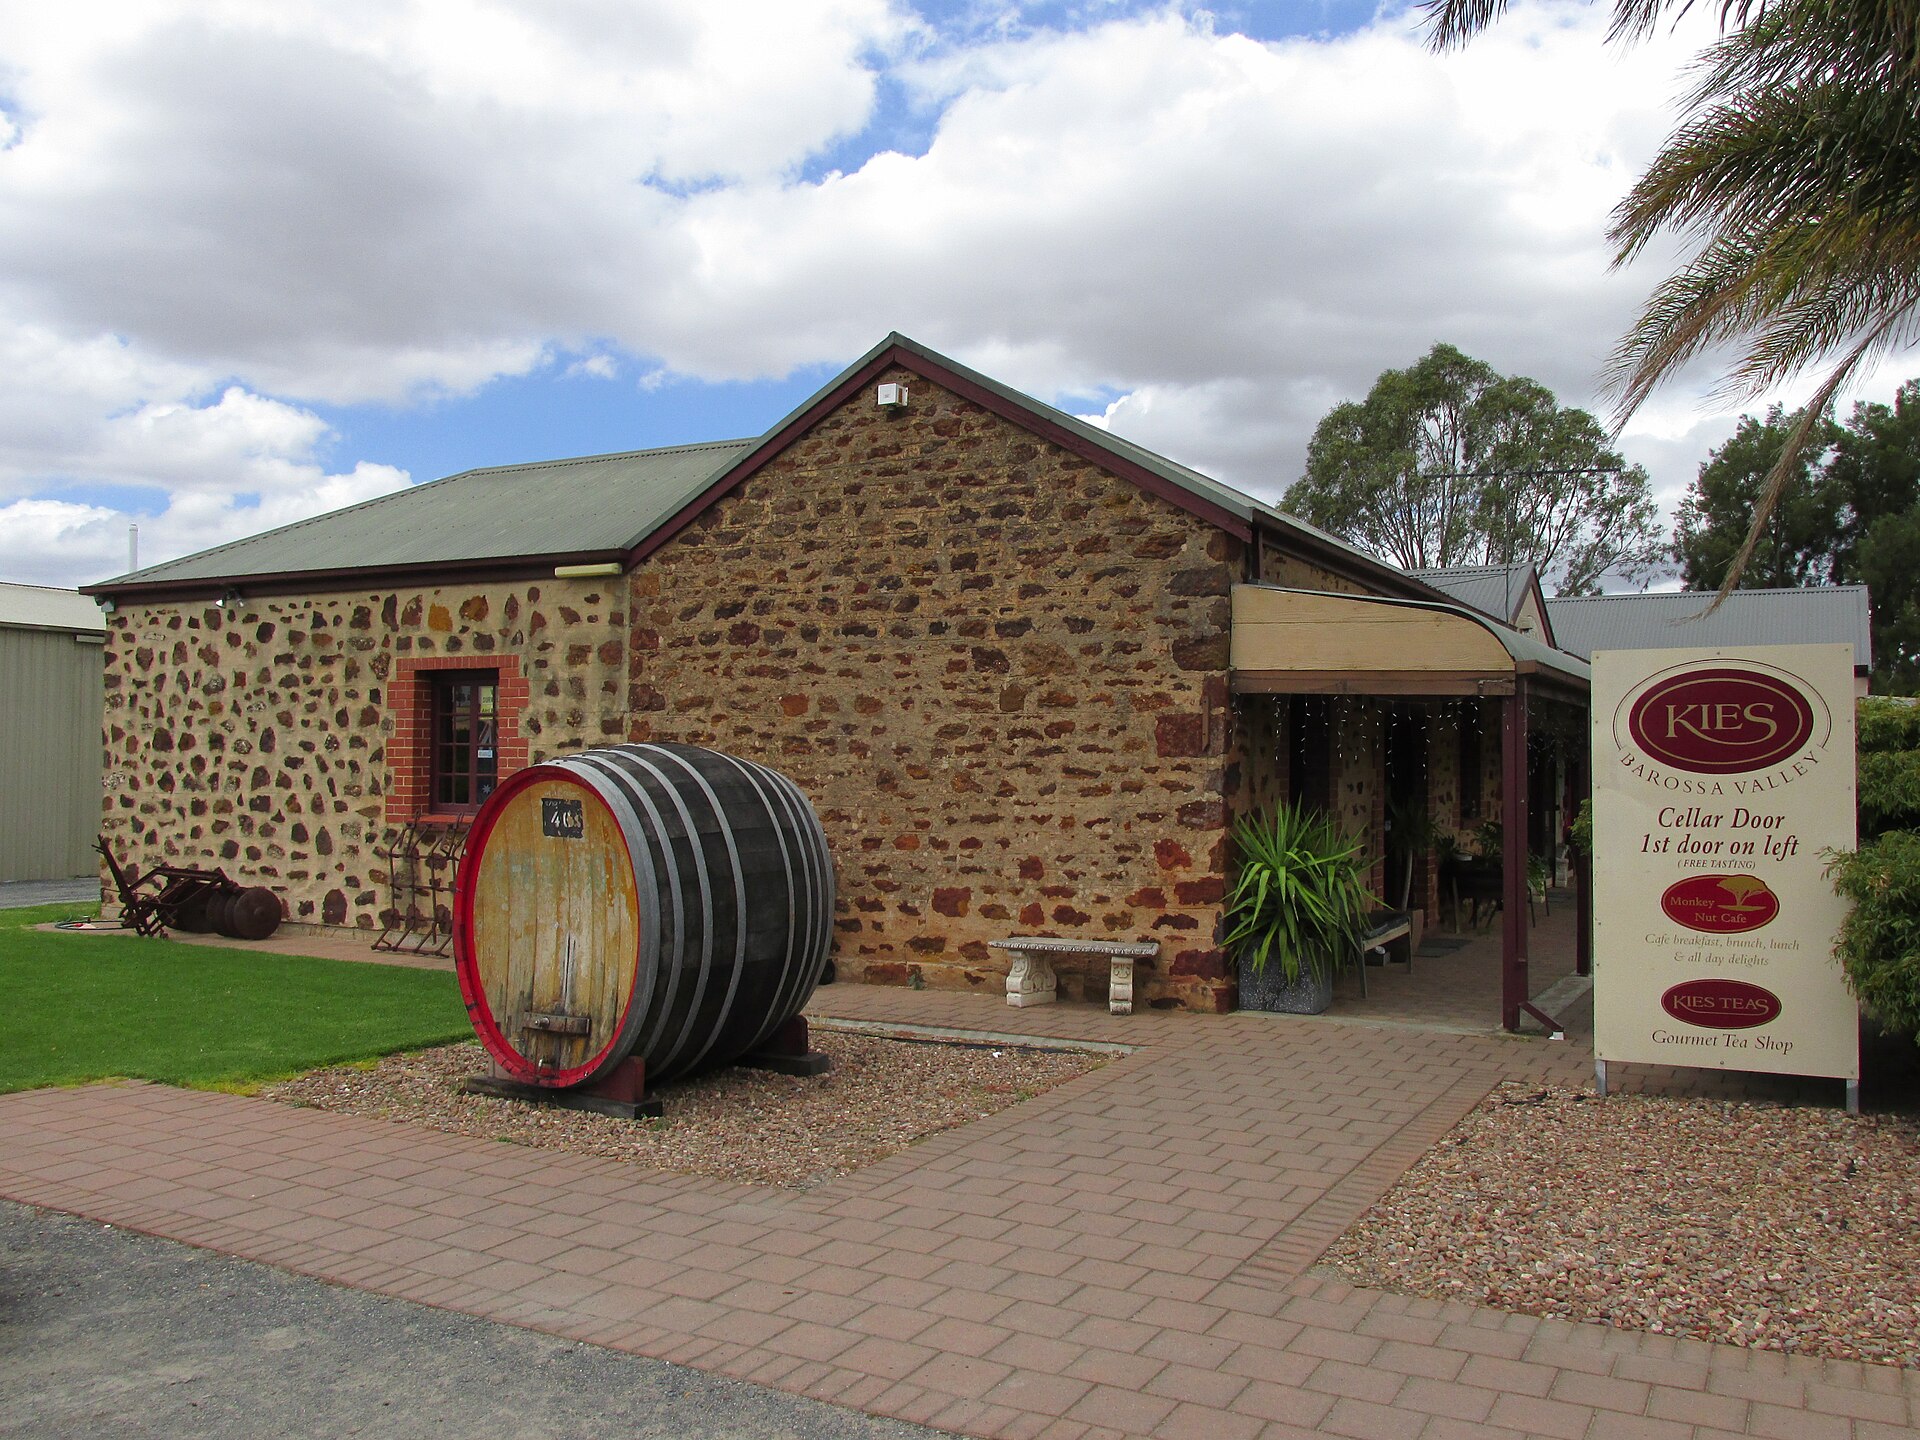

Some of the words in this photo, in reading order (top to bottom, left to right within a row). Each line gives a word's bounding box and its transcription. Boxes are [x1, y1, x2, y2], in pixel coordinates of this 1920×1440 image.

[1665, 703, 1777, 745] KIES
[1620, 752, 1723, 795] BAROSSA
[1734, 750, 1820, 794] VALLEY
[1658, 807, 1724, 829] Cellar
[1730, 808, 1785, 829] Door
[1641, 833, 1670, 854] 1st
[1677, 834, 1724, 854] door
[1729, 842, 1755, 855] on
[1763, 835, 1800, 861] left
[1710, 859, 1756, 870] TASTING)
[1670, 897, 1716, 909] Monkey
[1695, 913, 1717, 922] Nut
[1721, 913, 1747, 923] Cafe
[1645, 933, 1671, 946] Cafe
[1673, 935, 1723, 948] breakfast,
[1726, 937, 1766, 950] brunch,
[1769, 939, 1800, 951] lunch
[1674, 952, 1685, 962] &
[1687, 952, 1702, 963] all
[1705, 954, 1724, 967] day
[1728, 954, 1770, 967] delights
[1672, 995, 1716, 1010] KIES
[1718, 998, 1769, 1016] TEAS
[1652, 1030, 1718, 1047] Gourmet
[1722, 1033, 1748, 1048] Tea
[1755, 1035, 1794, 1055] Shop
